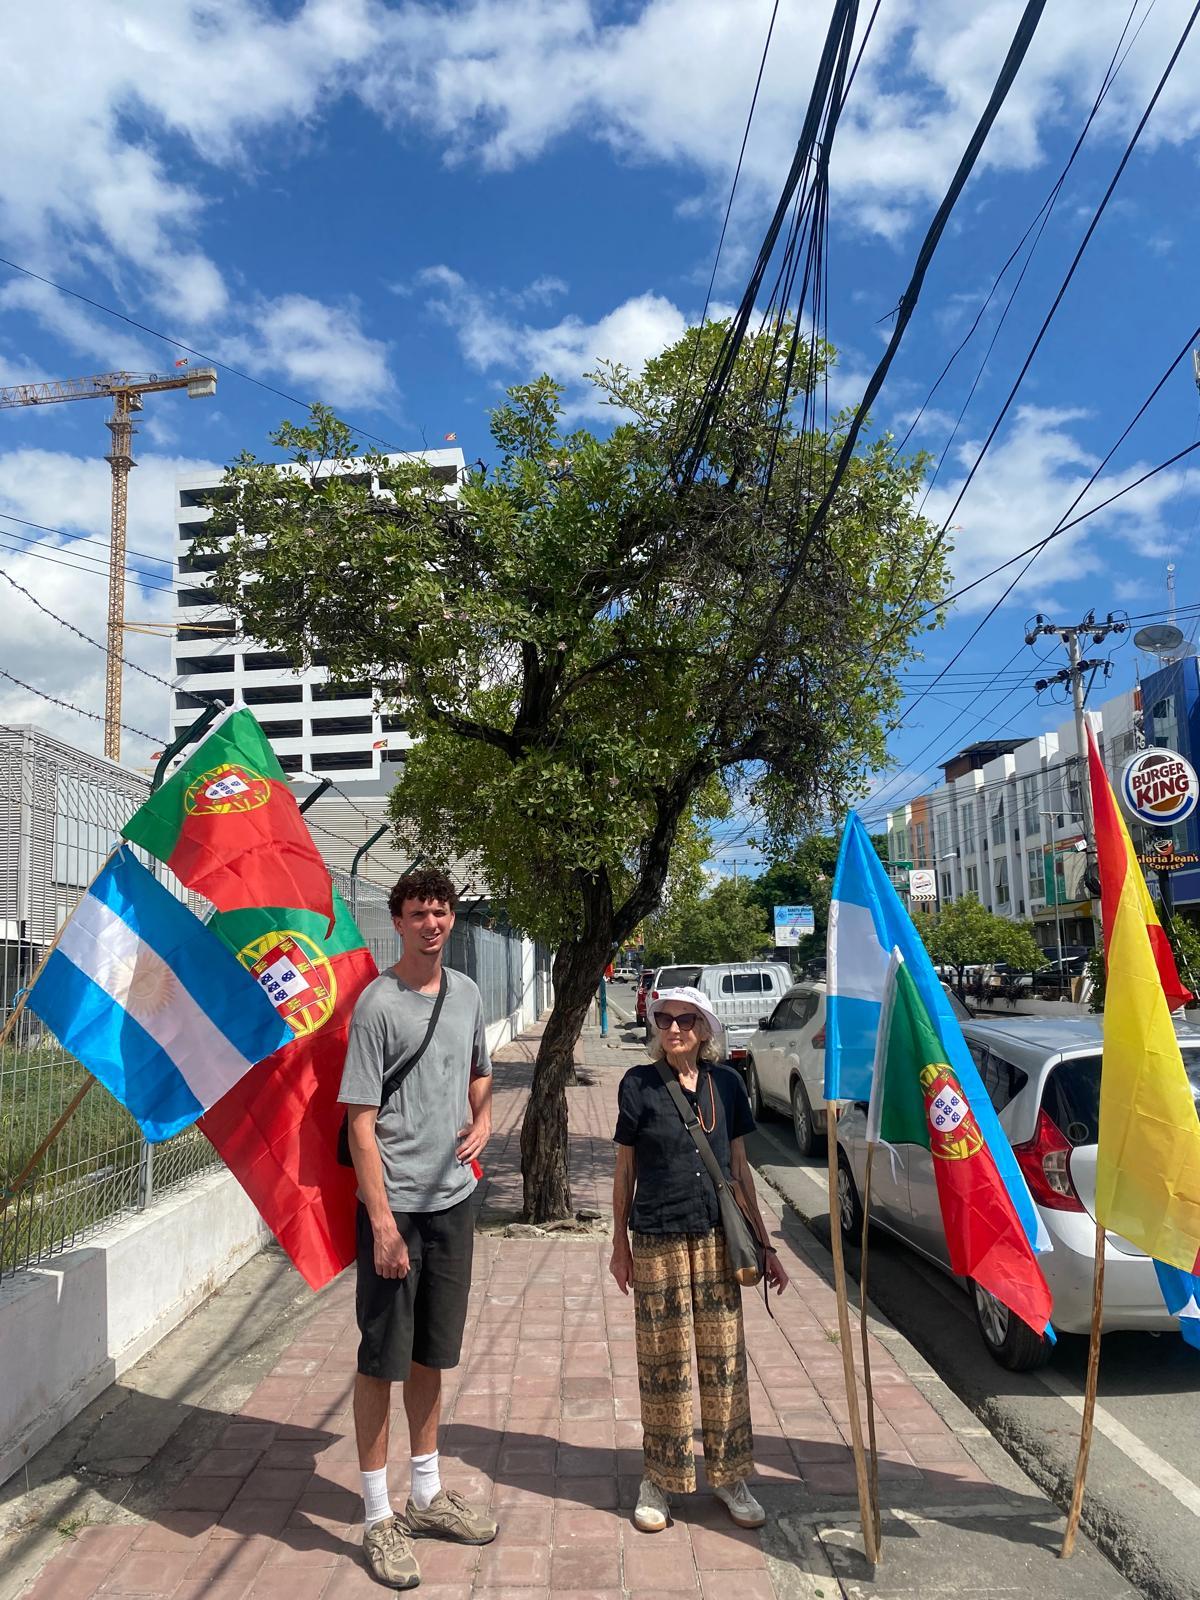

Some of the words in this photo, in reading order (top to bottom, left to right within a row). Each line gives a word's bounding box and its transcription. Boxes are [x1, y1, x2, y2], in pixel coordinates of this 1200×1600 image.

[1132, 762, 1185, 790] BURGER
[1136, 774, 1190, 809] KING
[1149, 862, 1185, 871] COFFEES
[1170, 853, 1199, 864] Jean's
